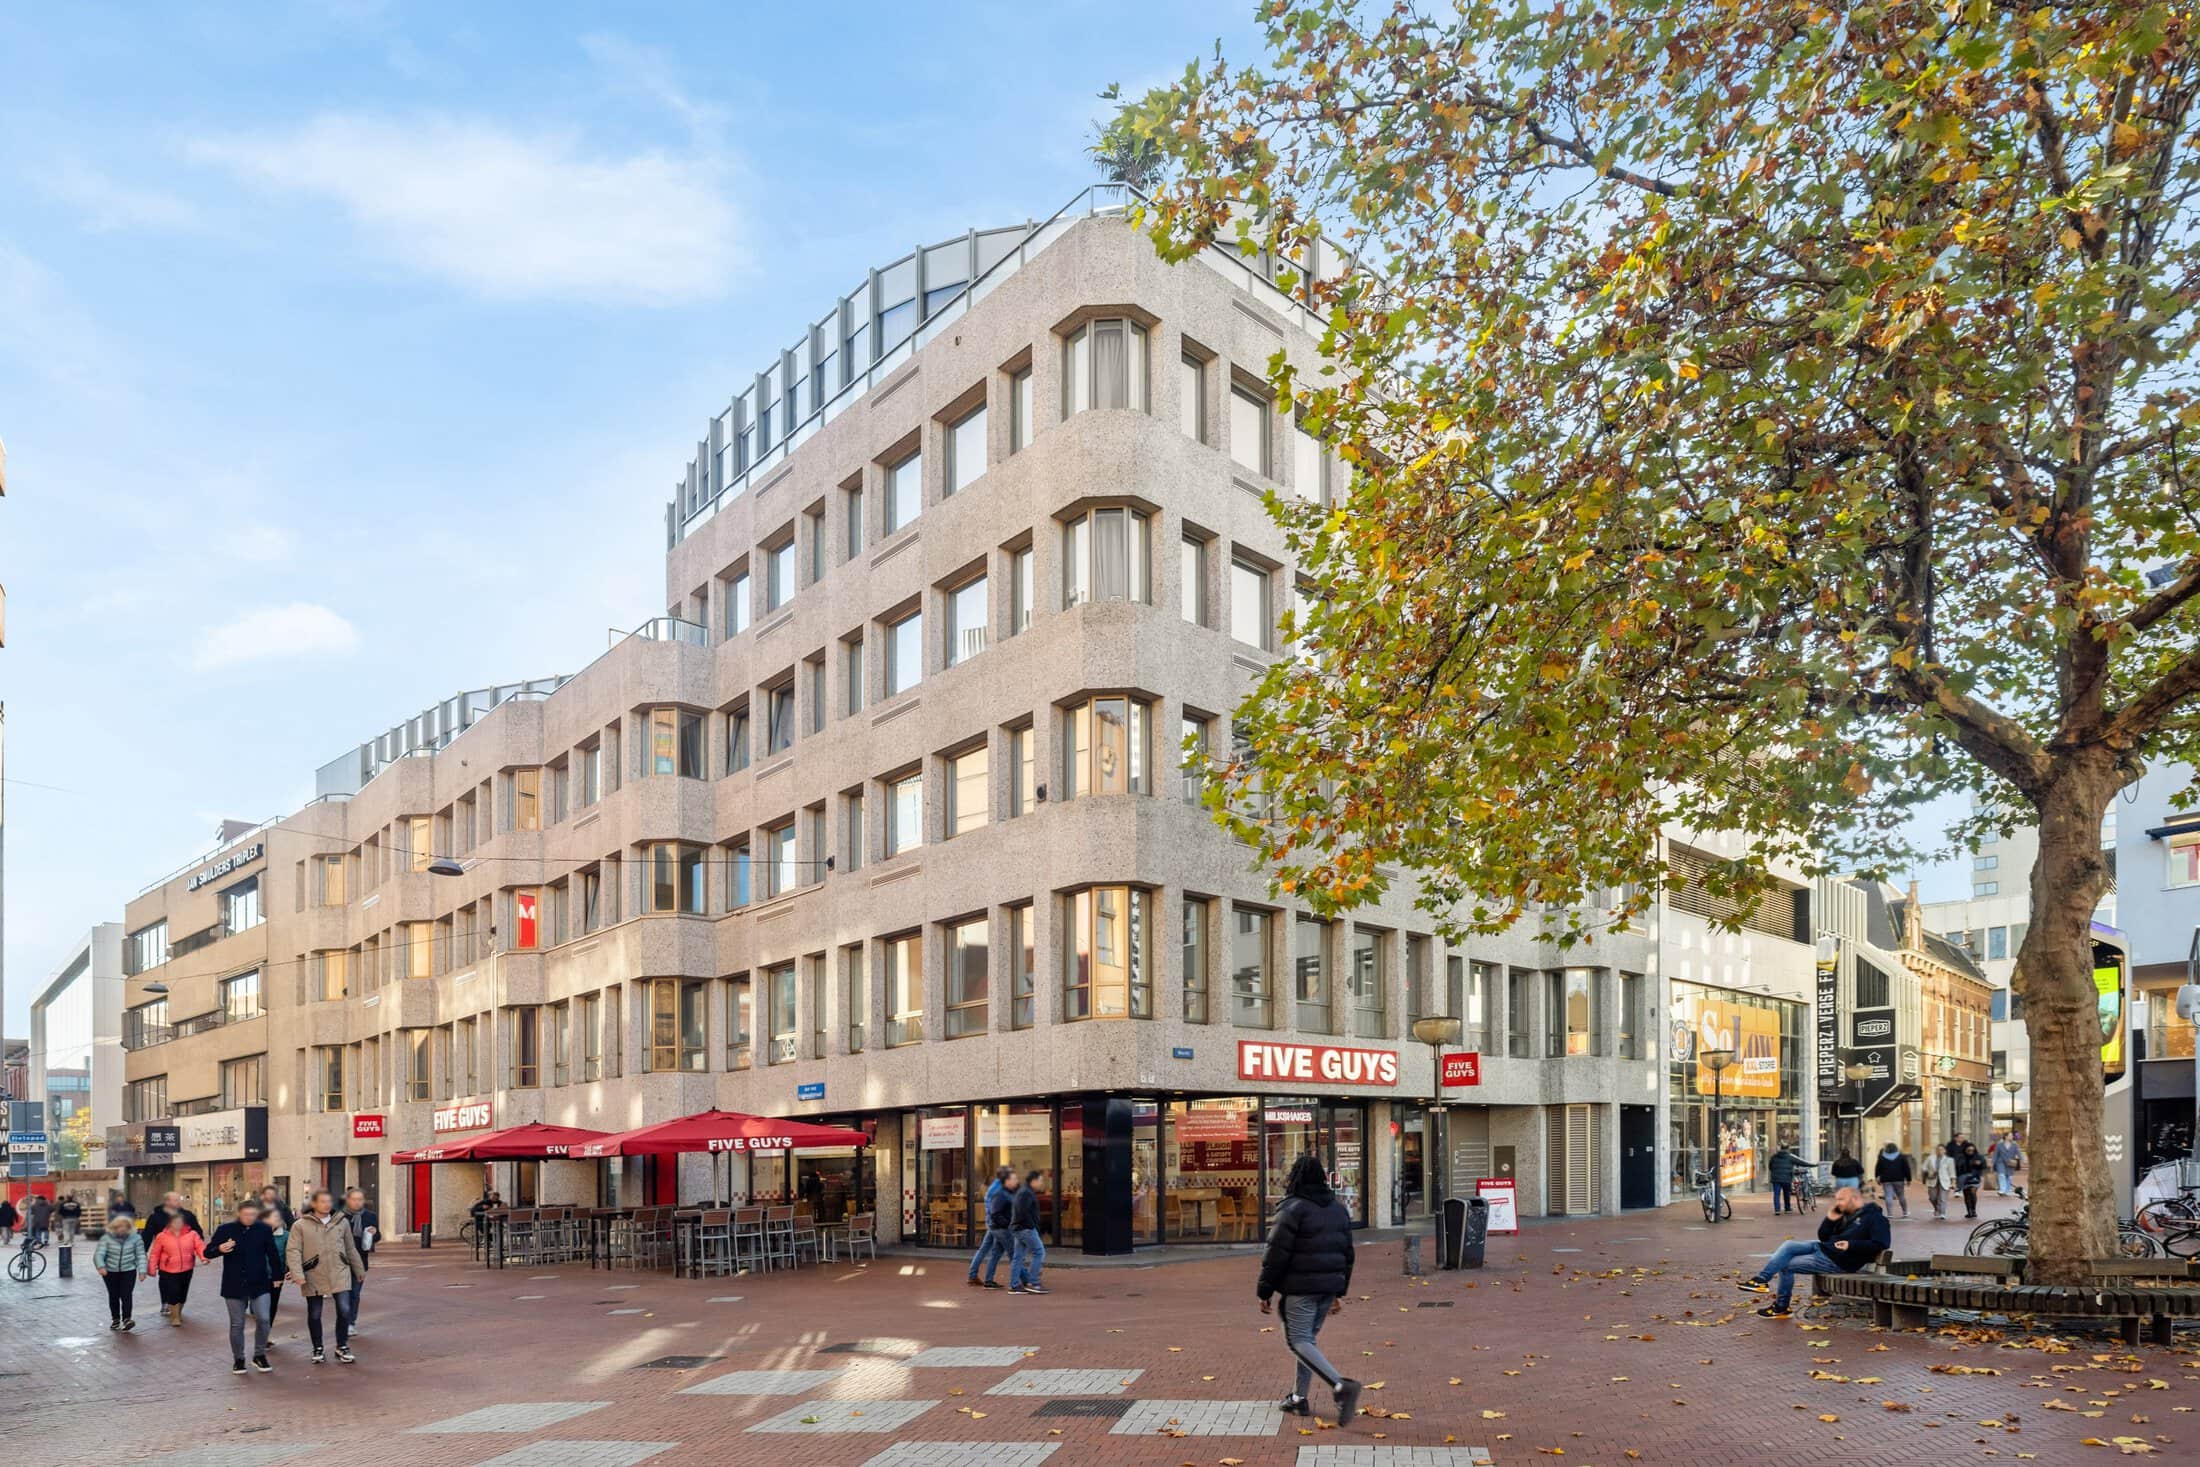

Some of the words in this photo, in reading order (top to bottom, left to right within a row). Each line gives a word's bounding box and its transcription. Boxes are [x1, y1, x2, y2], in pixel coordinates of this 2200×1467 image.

[187, 876, 198, 890] JAN
[199, 859, 231, 886] SMULDERS
[1817, 988, 1834, 1023] VERSE
[1861, 1024, 1888, 1034] PIEPERZ
[1818, 1031, 1835, 1075] PIEPERZ
[1243, 1045, 1313, 1078] FIVE
[1321, 1049, 1397, 1082] GUYS
[1448, 1062, 1472, 1070] FIVE
[1445, 1069, 1475, 1078] GUYS
[434, 1109, 457, 1130] FIVE
[458, 1104, 489, 1127] GUYS
[1264, 1111, 1312, 1121] MILKSHAKES
[546, 1145, 568, 1154] FIV
[708, 1138, 744, 1151] FIVE
[749, 1136, 793, 1148] GUYS
